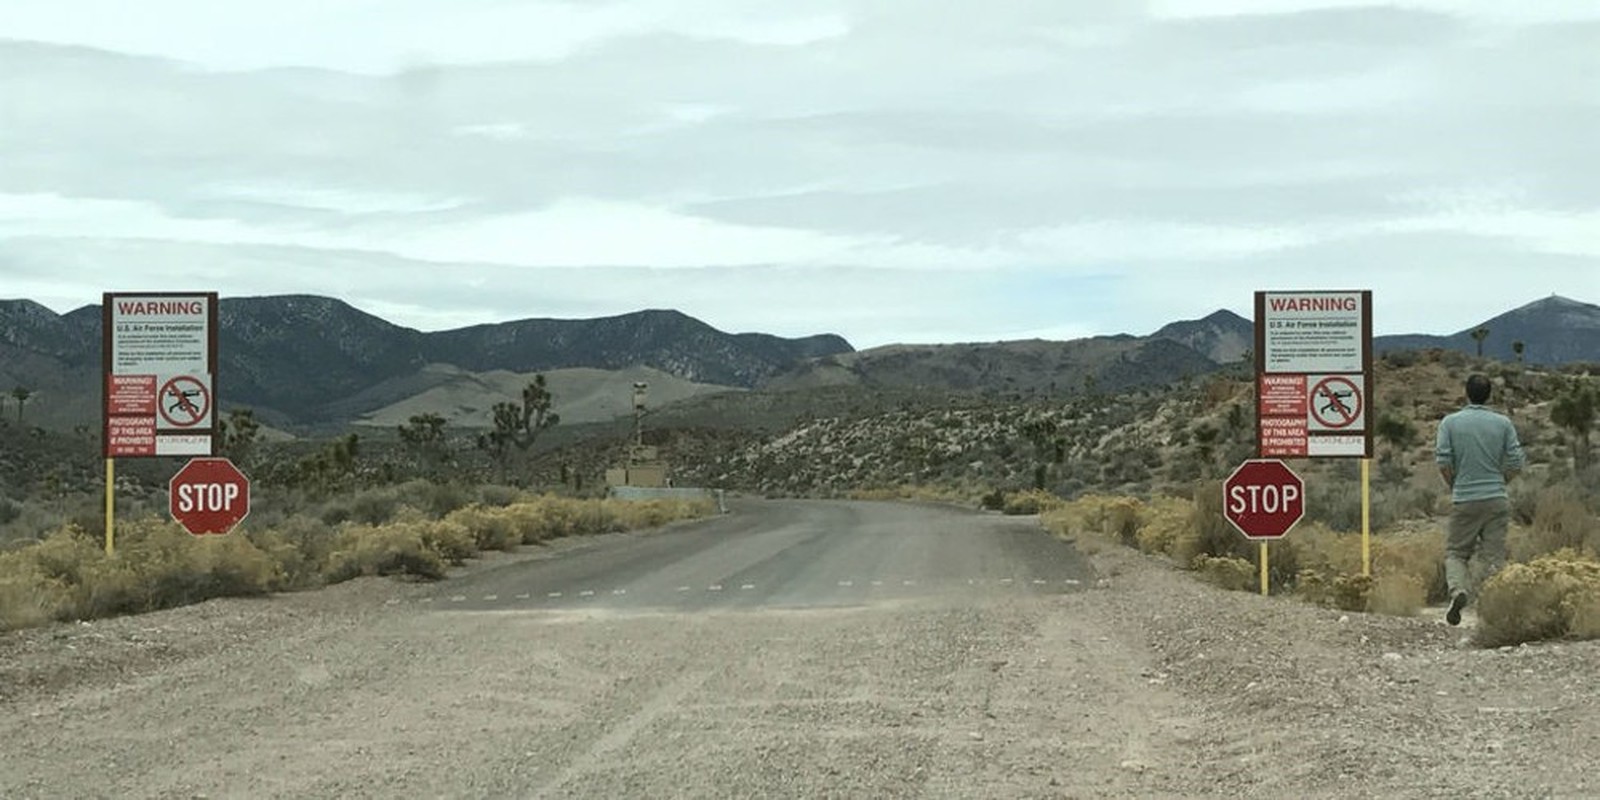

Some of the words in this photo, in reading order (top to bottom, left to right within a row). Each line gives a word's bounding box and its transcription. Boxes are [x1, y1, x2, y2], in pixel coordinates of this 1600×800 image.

[118, 302, 203, 315] WARNING
[1270, 298, 1357, 311] WARNING
[109, 418, 155, 426] PHOTOGRAPHY
[1261, 419, 1307, 427] PHOTOGRAPHY
[178, 483, 239, 512] STOP
[1230, 484, 1298, 513] STOP
